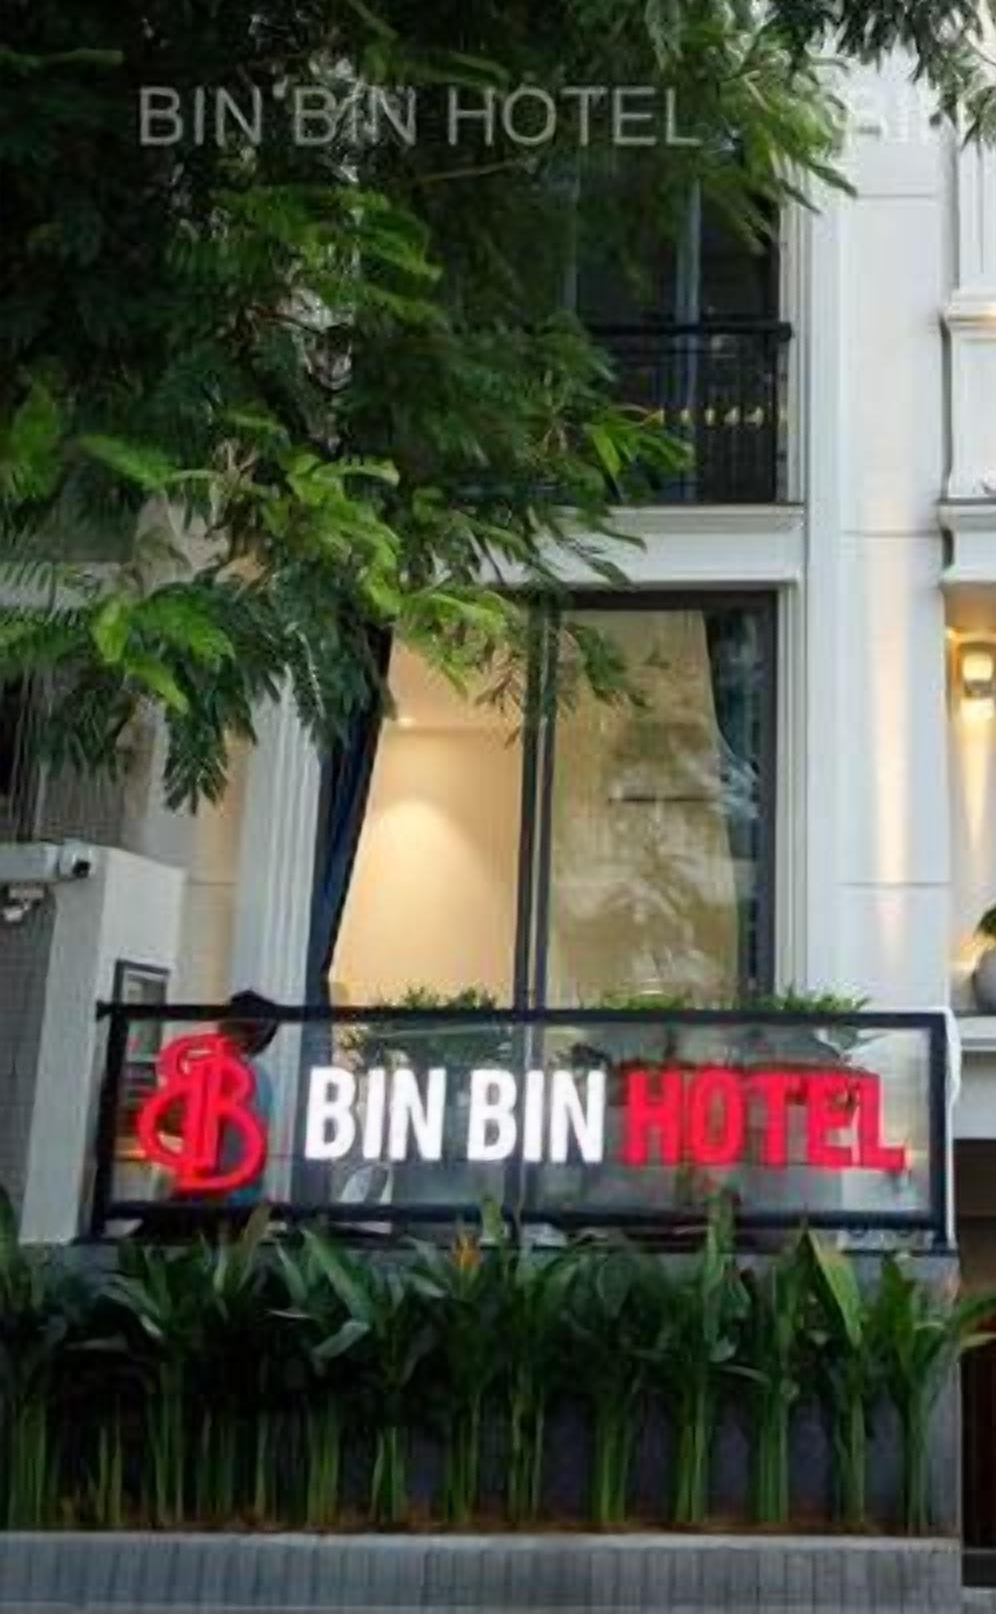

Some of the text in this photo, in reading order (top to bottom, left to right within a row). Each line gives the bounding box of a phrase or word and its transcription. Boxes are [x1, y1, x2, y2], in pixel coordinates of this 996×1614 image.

[303, 1066, 908, 1172] BIN BIN HOTEL
